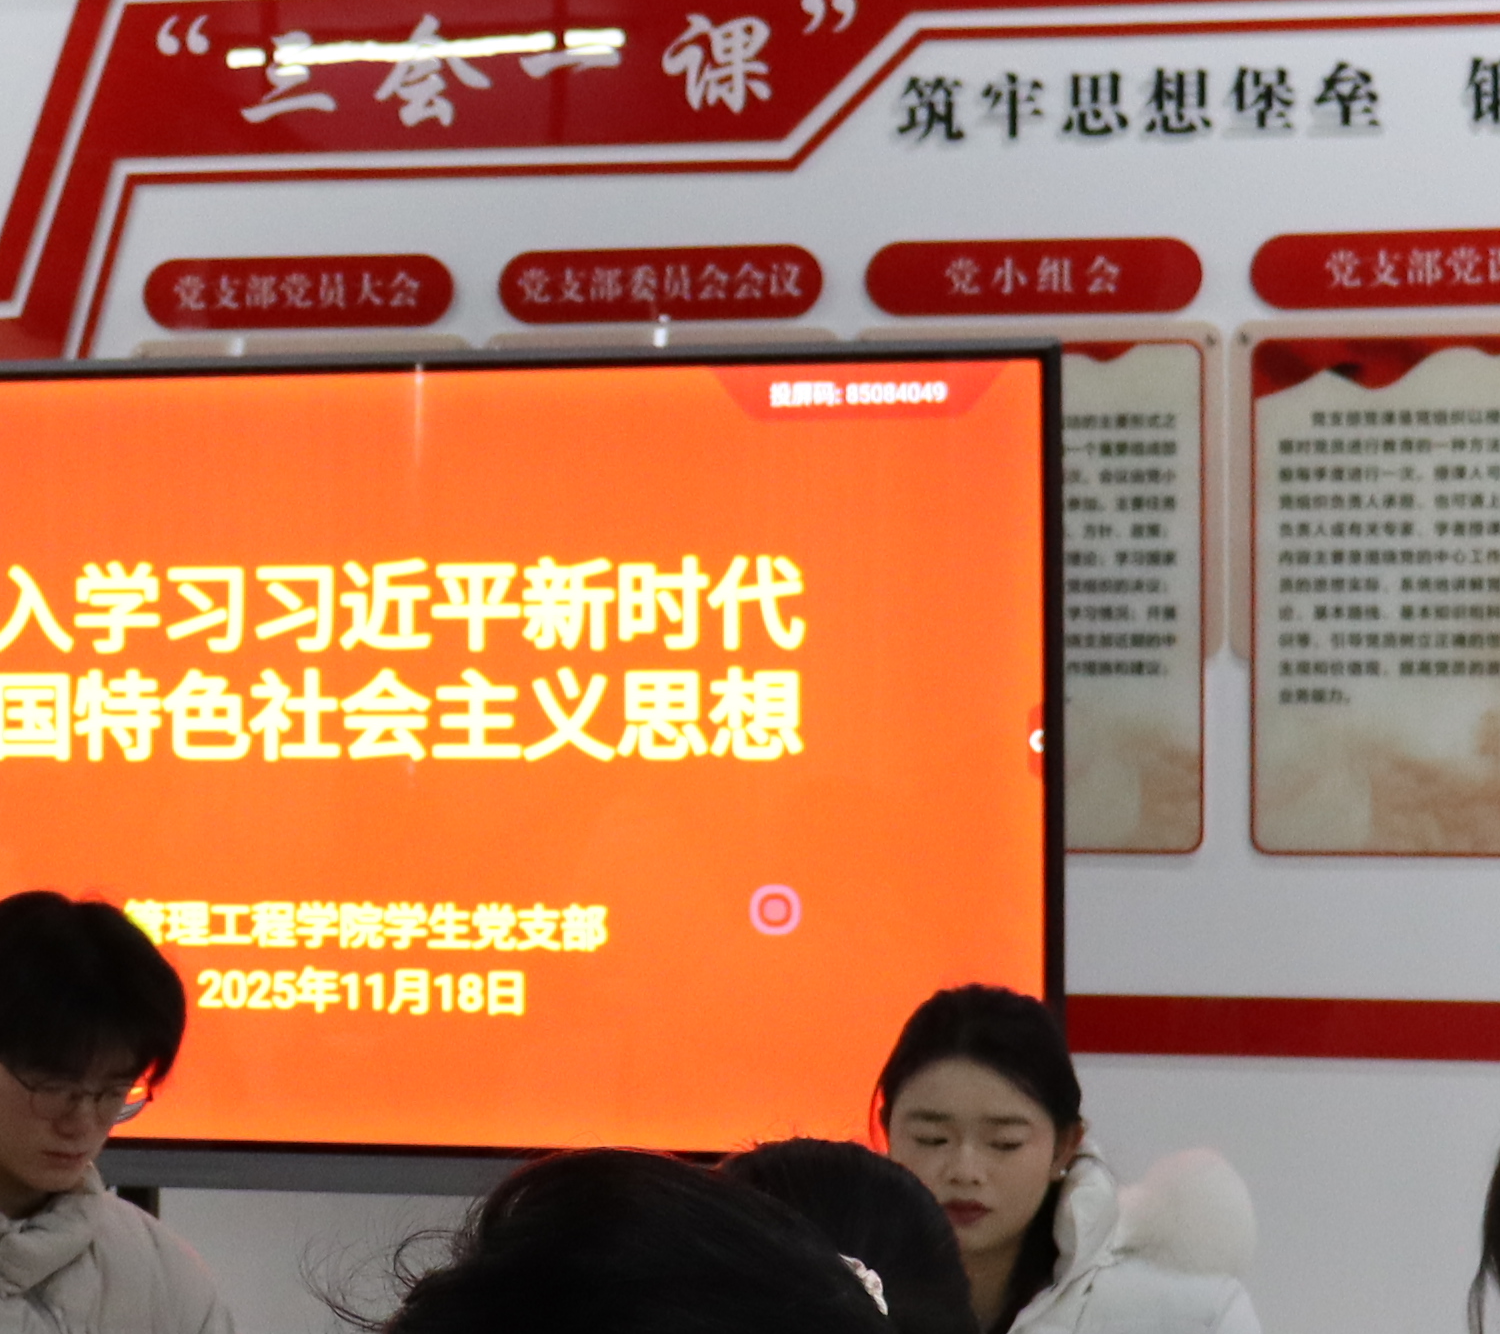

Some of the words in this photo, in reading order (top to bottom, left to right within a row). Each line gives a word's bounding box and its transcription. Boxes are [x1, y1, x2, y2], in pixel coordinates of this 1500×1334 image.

[897, 61, 1382, 142] 筑牢思想堡垒
[172, 271, 423, 311] 党支部党员大会
[517, 263, 802, 305] 党支部委员会会议
[944, 253, 1122, 296] 党小组会
[123, 899, 610, 953] 管理工程学院学生党支部
[196, 964, 527, 1017] 2025年11月18日
